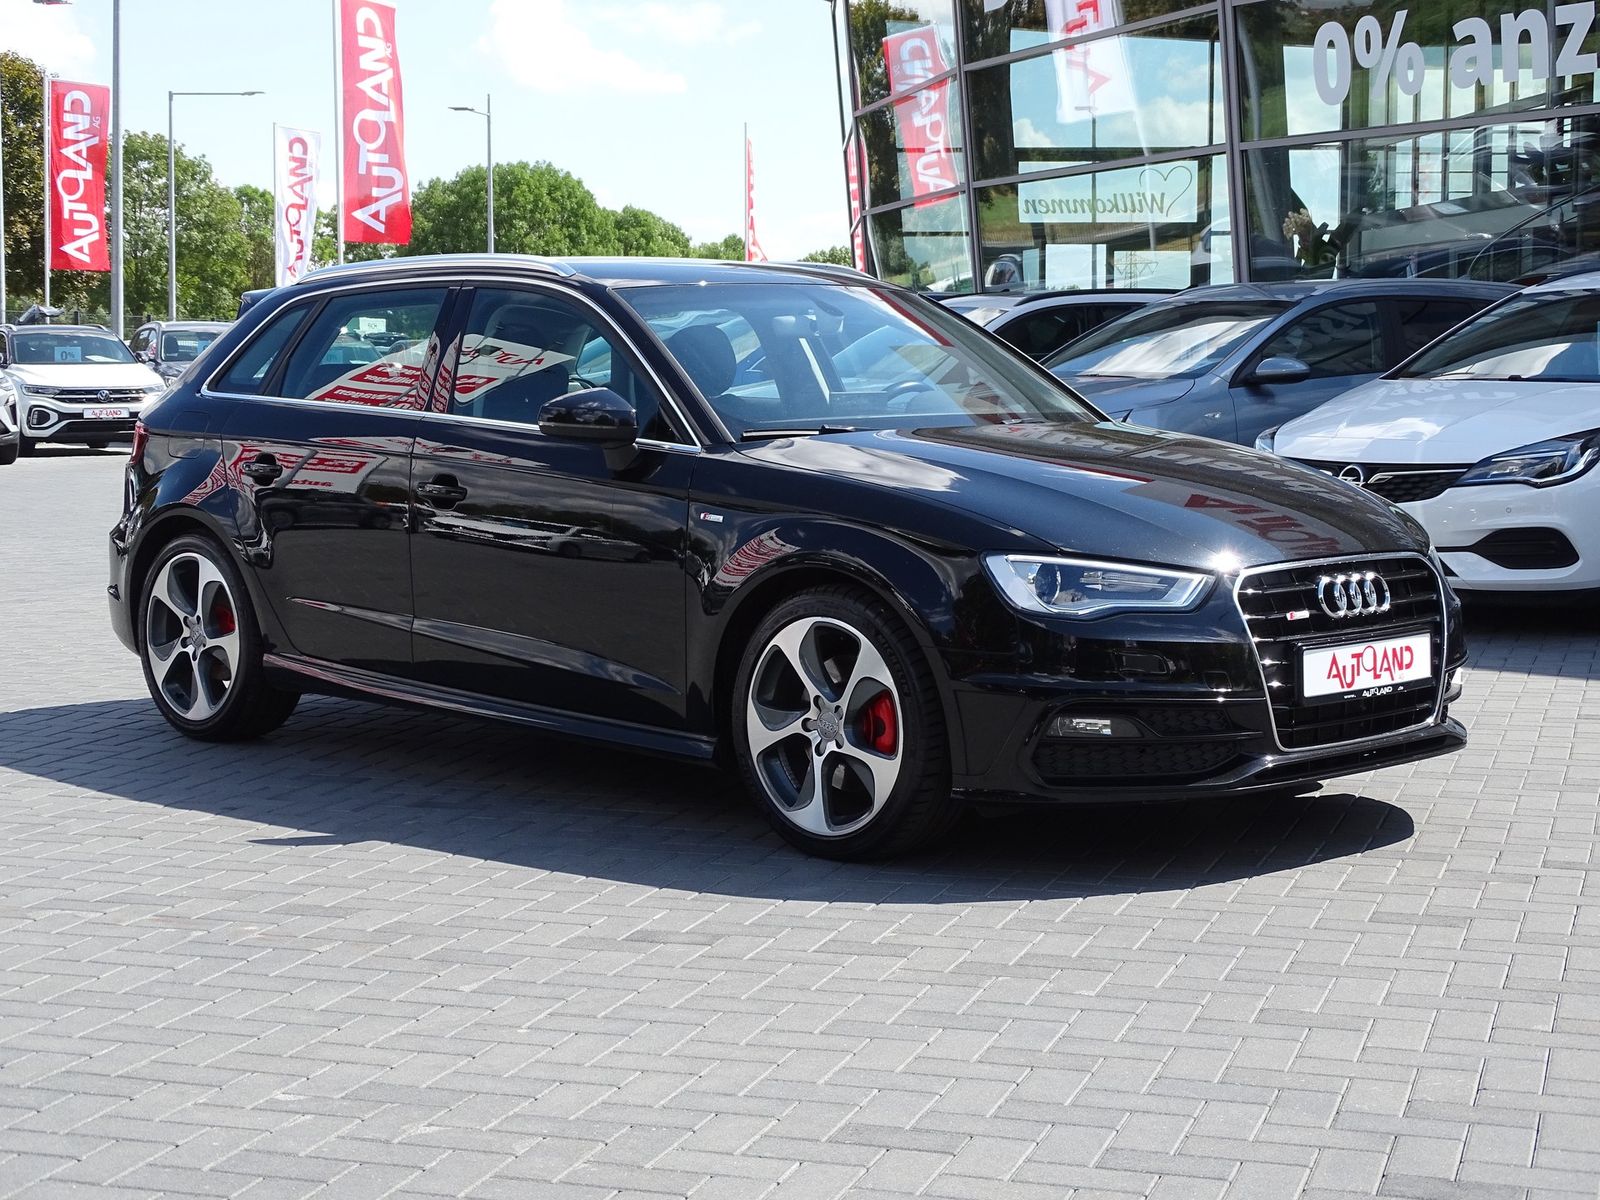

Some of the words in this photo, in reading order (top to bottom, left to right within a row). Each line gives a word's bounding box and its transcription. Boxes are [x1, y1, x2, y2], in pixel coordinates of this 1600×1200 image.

[1312, 10, 1425, 106] 0%
[1449, 1, 1599, 89] anz
[352, 6, 404, 234] AUTOLAND
[56, 90, 100, 263] AUTOLAND
[1326, 645, 1414, 689] AUTOLAND
[1361, 686, 1393, 698] AUTOLAND
